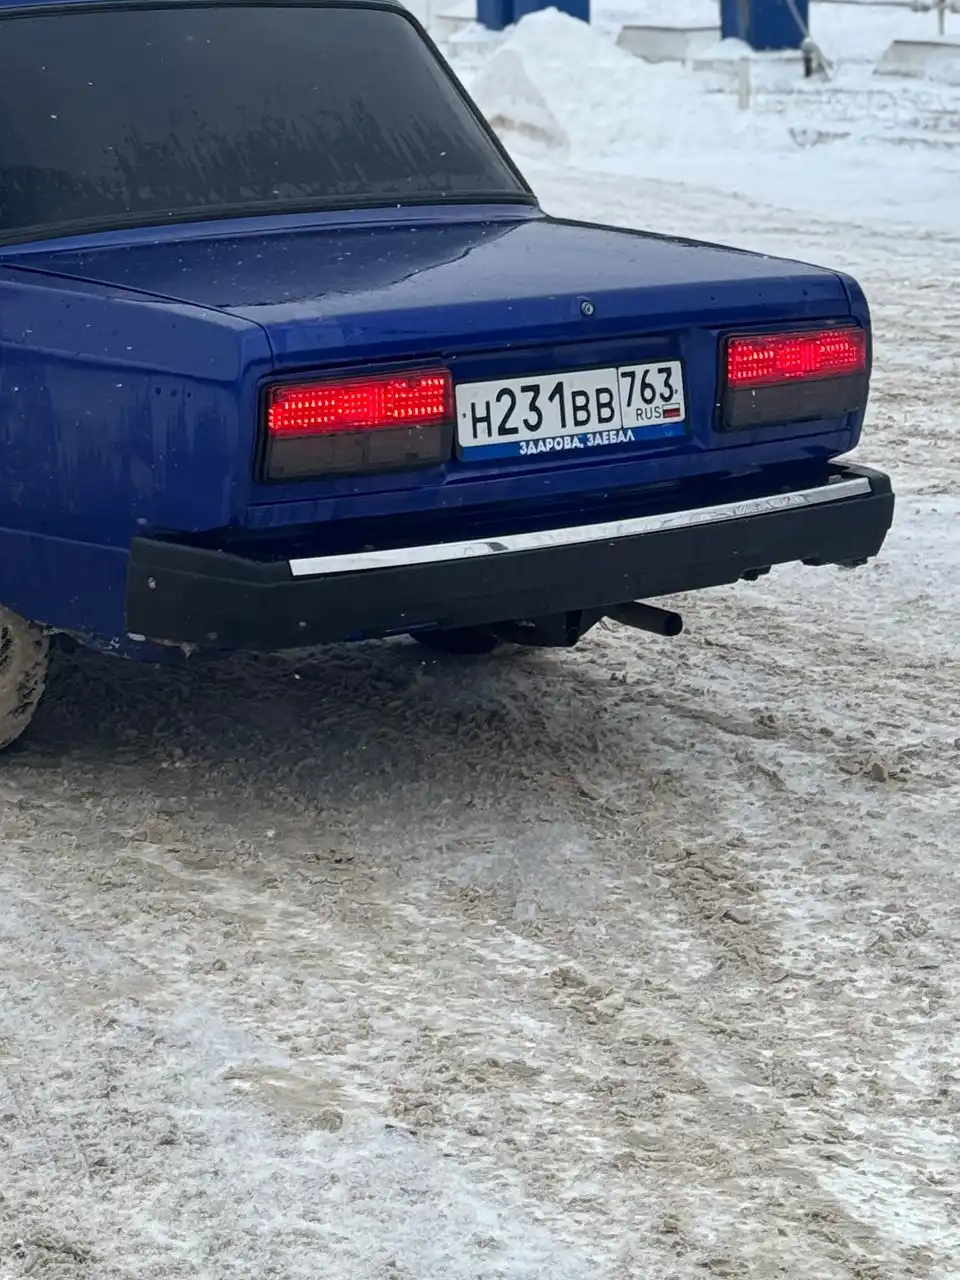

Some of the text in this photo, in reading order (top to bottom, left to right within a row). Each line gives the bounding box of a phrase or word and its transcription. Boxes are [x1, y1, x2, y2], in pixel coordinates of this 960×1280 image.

[470, 367, 674, 439] Н231ВВ 763
[635, 406, 662, 421] RUS
[587, 428, 635, 446] ЗАЕБАЛ
